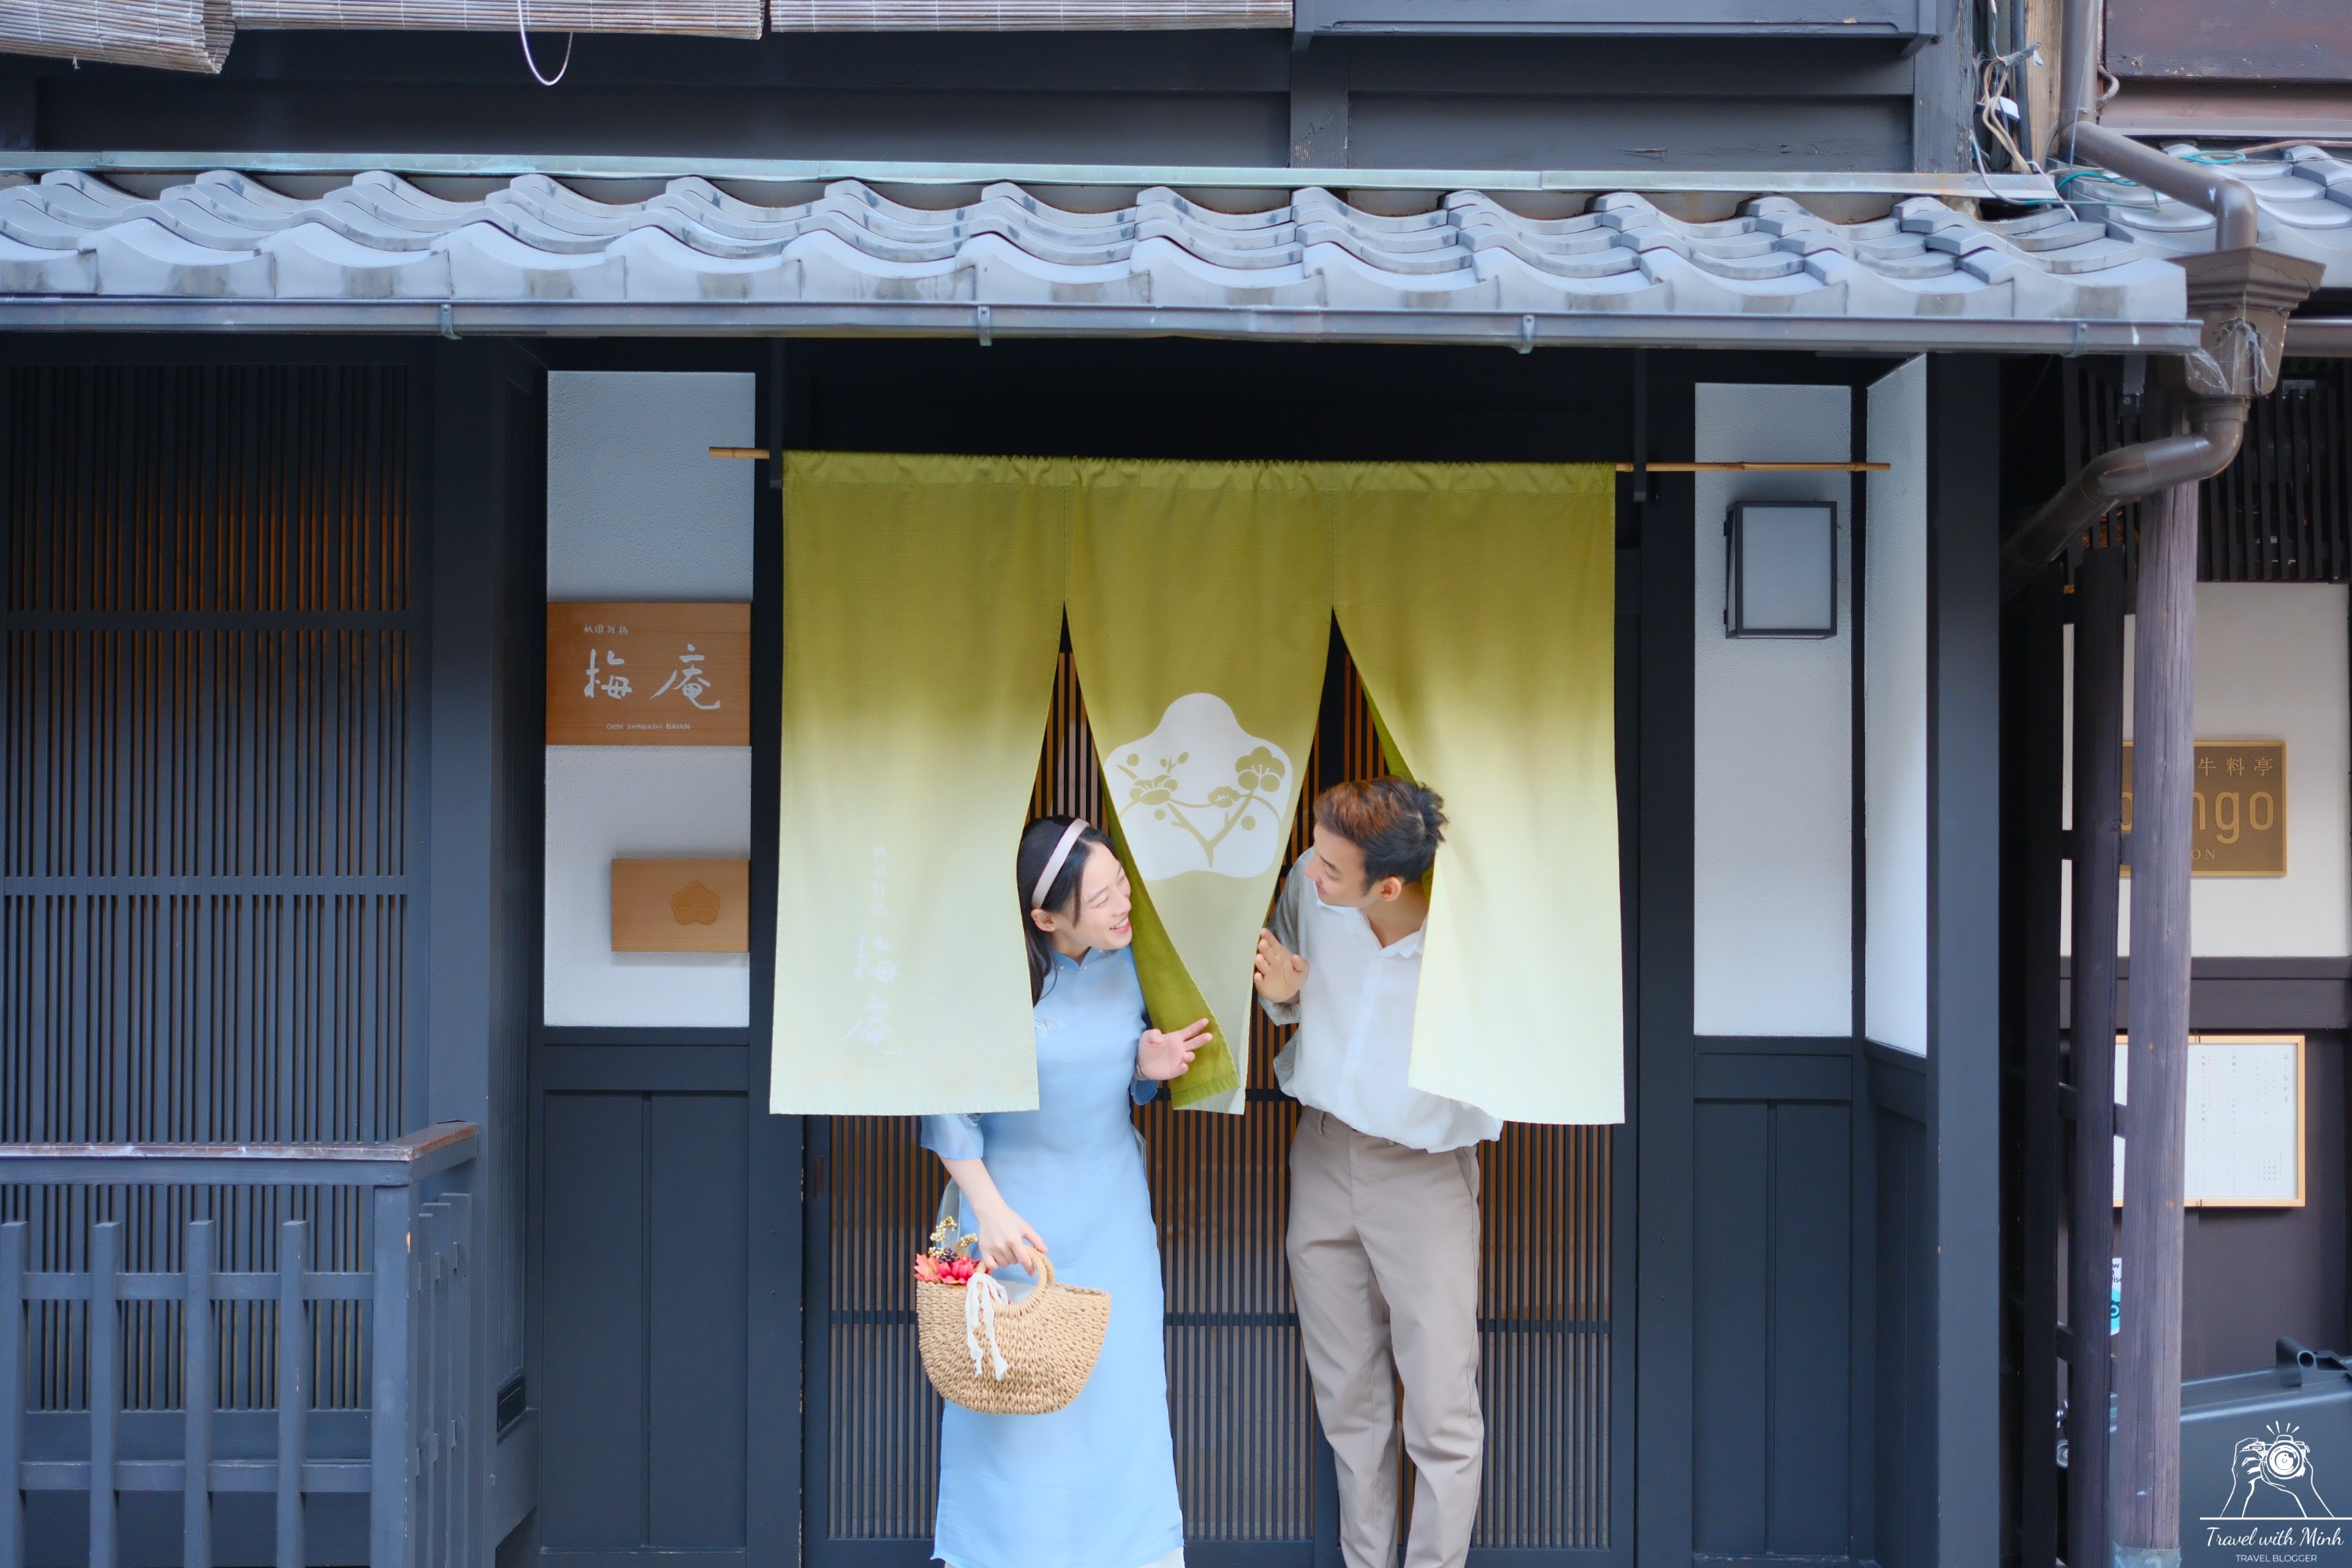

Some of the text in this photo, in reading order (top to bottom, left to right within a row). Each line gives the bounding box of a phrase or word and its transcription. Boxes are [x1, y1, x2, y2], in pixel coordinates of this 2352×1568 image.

[584, 644, 720, 710] 梅庵
[2198, 757, 2274, 777] 牛料亭
[2190, 849, 2215, 860] ON
[837, 934, 902, 1055] 梅庵
